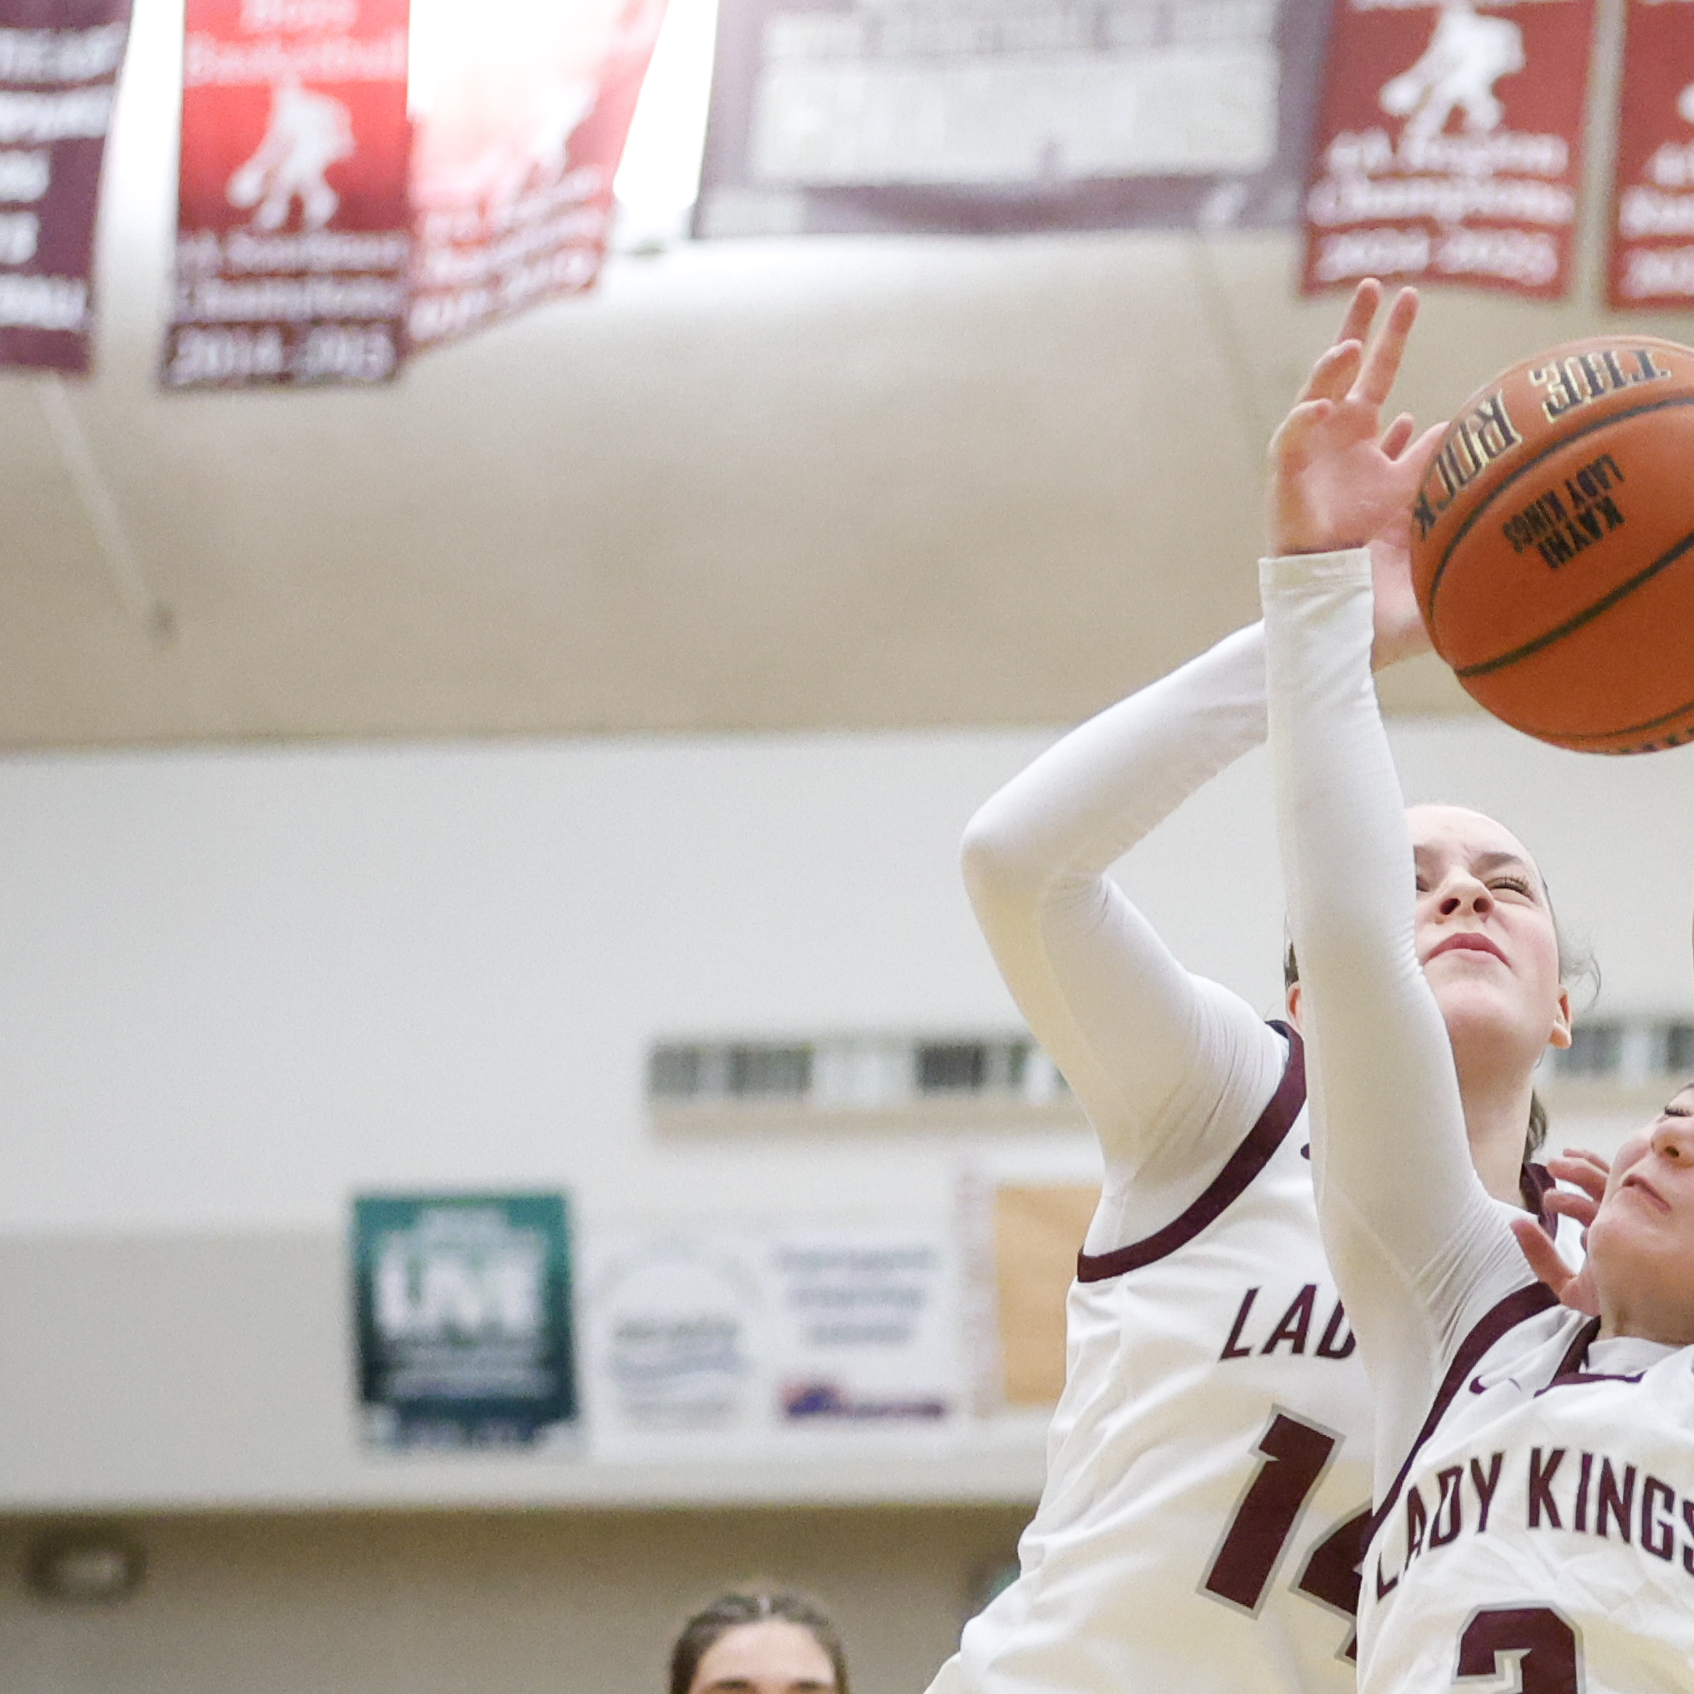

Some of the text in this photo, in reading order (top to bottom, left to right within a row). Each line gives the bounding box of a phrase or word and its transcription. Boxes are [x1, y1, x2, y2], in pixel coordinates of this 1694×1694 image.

[1530, 350, 1672, 424] THE
[1564, 453, 1626, 509] LADY
[1219, 1283, 1356, 1363] LAD
[1374, 1449, 1505, 1601] LADY
